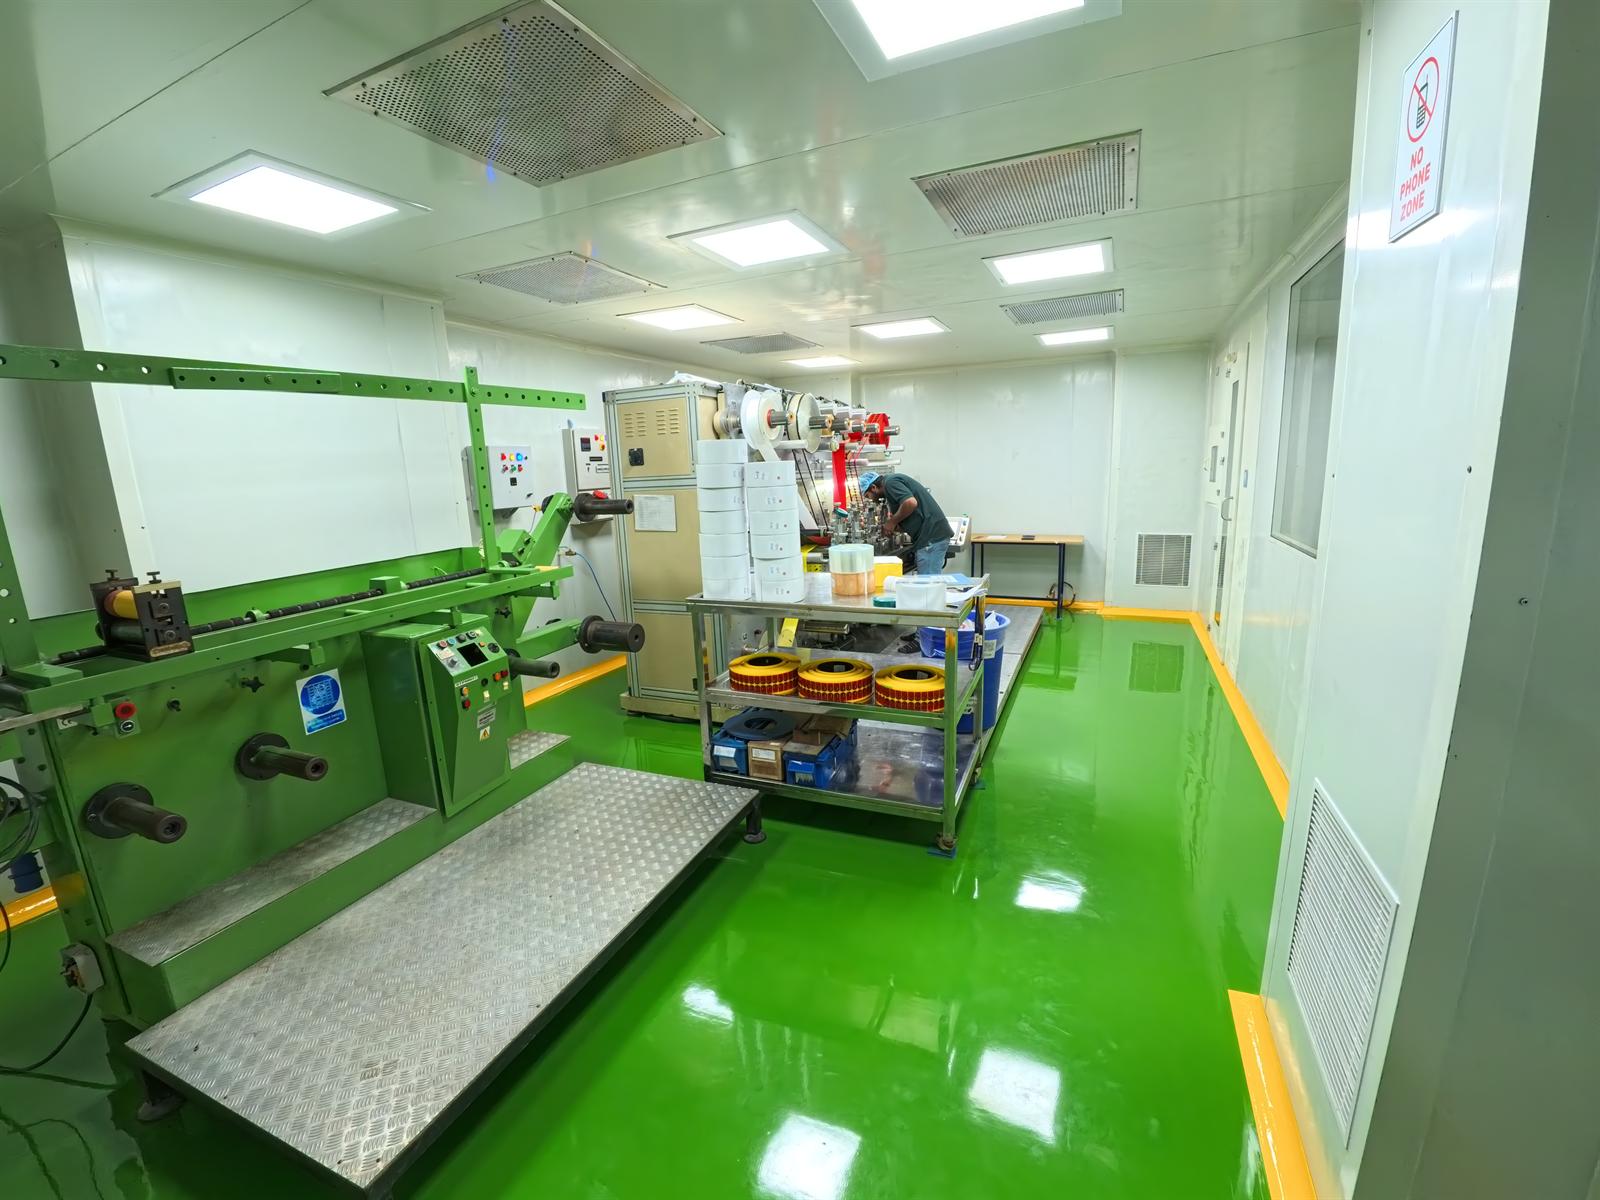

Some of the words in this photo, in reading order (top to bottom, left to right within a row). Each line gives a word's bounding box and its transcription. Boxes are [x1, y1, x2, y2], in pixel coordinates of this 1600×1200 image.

[1410, 147, 1424, 171] NO
[1400, 163, 1431, 201] PHONE
[1400, 191, 1425, 222] ZONE
